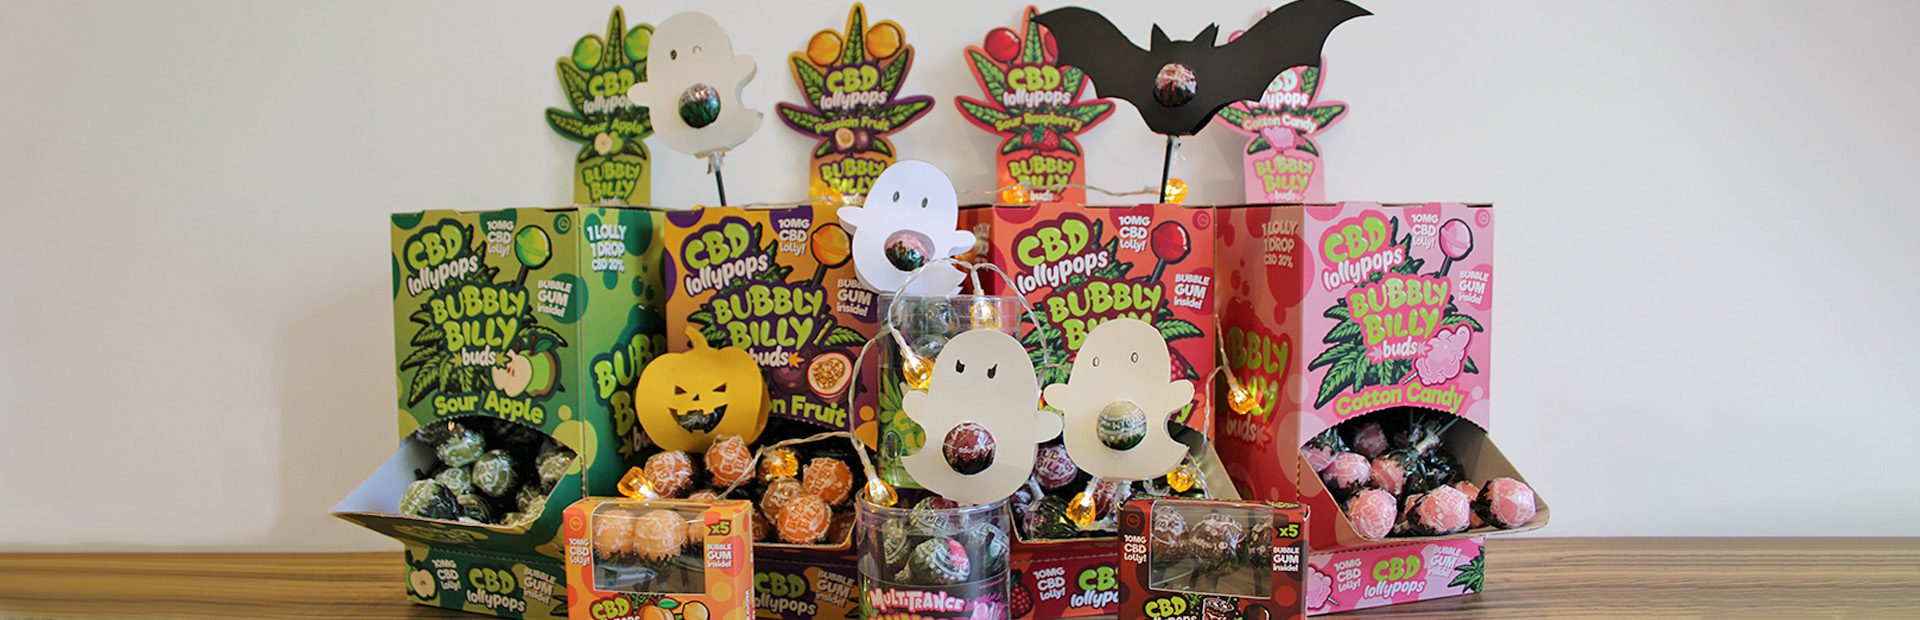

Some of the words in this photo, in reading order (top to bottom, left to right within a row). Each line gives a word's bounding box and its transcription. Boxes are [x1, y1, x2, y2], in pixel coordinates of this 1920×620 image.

[589, 68, 636, 97] CBD
[826, 65, 878, 94] CBD
[1007, 65, 1061, 92] CBD
[1267, 69, 1298, 92] BD
[583, 94, 634, 115] lollypop
[820, 90, 888, 111] lollypops
[1003, 89, 1072, 108] lollypops
[611, 118, 644, 134] Apple
[815, 116, 859, 133] Passion
[861, 115, 891, 132] Fruit
[995, 117, 1022, 132] Sour
[1024, 112, 1083, 132] Raspberry
[1282, 114, 1317, 134] Candy
[583, 161, 641, 182] BUBBLY
[821, 158, 886, 181] BUBBLY
[1008, 156, 1075, 177] BUBBLY
[1254, 156, 1313, 176] BUBBLY
[590, 179, 635, 199] BILLY
[1264, 174, 1308, 193] BILLY
[486, 220, 514, 231] 10MG
[778, 218, 810, 229] 10MG
[1118, 215, 1150, 227] 10MG
[1268, 220, 1298, 236] LOLLY
[1411, 214, 1438, 223] 10MG
[486, 231, 511, 244] CBD
[595, 224, 628, 240] LOLLY
[778, 230, 808, 243] CBD
[1119, 226, 1148, 240] CBD
[1324, 216, 1386, 263] CBD
[1412, 224, 1437, 237] CBD
[407, 221, 463, 271] CBD
[598, 241, 625, 257] DROP
[685, 222, 750, 270] CBD
[1017, 219, 1089, 267] CBD
[1270, 237, 1294, 253] DROP
[407, 255, 478, 296] lollypops
[685, 254, 769, 296] lollypops
[1017, 250, 1108, 294] lollypops
[1324, 247, 1403, 290] lollypops
[1459, 269, 1489, 282] BUBBLE
[537, 279, 573, 293] BUBBLE
[1174, 273, 1210, 286] BUBBLE
[1459, 279, 1486, 294] GUM
[537, 290, 569, 306] GUM
[837, 289, 872, 306] GUM
[1174, 283, 1207, 299] GUM
[1351, 277, 1448, 318] BUBBLY
[430, 284, 526, 326] BUBBLY
[712, 284, 823, 325] BUBBLY
[1047, 280, 1162, 323] BUBBLY
[442, 317, 517, 351] BILLY
[727, 317, 814, 350] BILLY
[1364, 307, 1440, 345] BILLY
[461, 346, 497, 367] buds
[1226, 326, 1288, 379] BBLY
[1383, 336, 1418, 358] buds
[434, 395, 478, 416] Sour
[484, 390, 544, 424] Apple
[1336, 386, 1403, 416] Cotton
[1407, 381, 1465, 414] Candy
[791, 395, 847, 428] Fruit
[711, 521, 732, 535] x5
[1278, 524, 1299, 537] x5
[1124, 535, 1147, 544] 10MG
[1124, 544, 1147, 554] CBD
[569, 546, 590, 556] CBD
[707, 550, 732, 560] GUM
[1273, 554, 1299, 564] GUM
[432, 559, 457, 569] 10MG
[1333, 558, 1362, 570] 10MG
[1373, 555, 1421, 581] CBD
[1430, 555, 1457, 568] GUM
[437, 569, 460, 580] CBD
[469, 568, 515, 594] CBD
[524, 567, 556, 584] BUBBLE
[817, 570, 855, 586] BUBBLE
[1033, 567, 1065, 580] 10MG
[1078, 566, 1118, 591] CB
[1336, 568, 1362, 583] CBD
[524, 577, 554, 596] GUM
[754, 572, 806, 598] CBD
[816, 579, 851, 598] GUM
[1037, 576, 1066, 591] CBD
[1364, 579, 1426, 598] lollypops
[467, 589, 525, 612] lollypops
[592, 597, 630, 619] CBD
[754, 592, 816, 616] ollypops
[1070, 589, 1119, 608] lollyp
[1145, 596, 1187, 618] CBD
